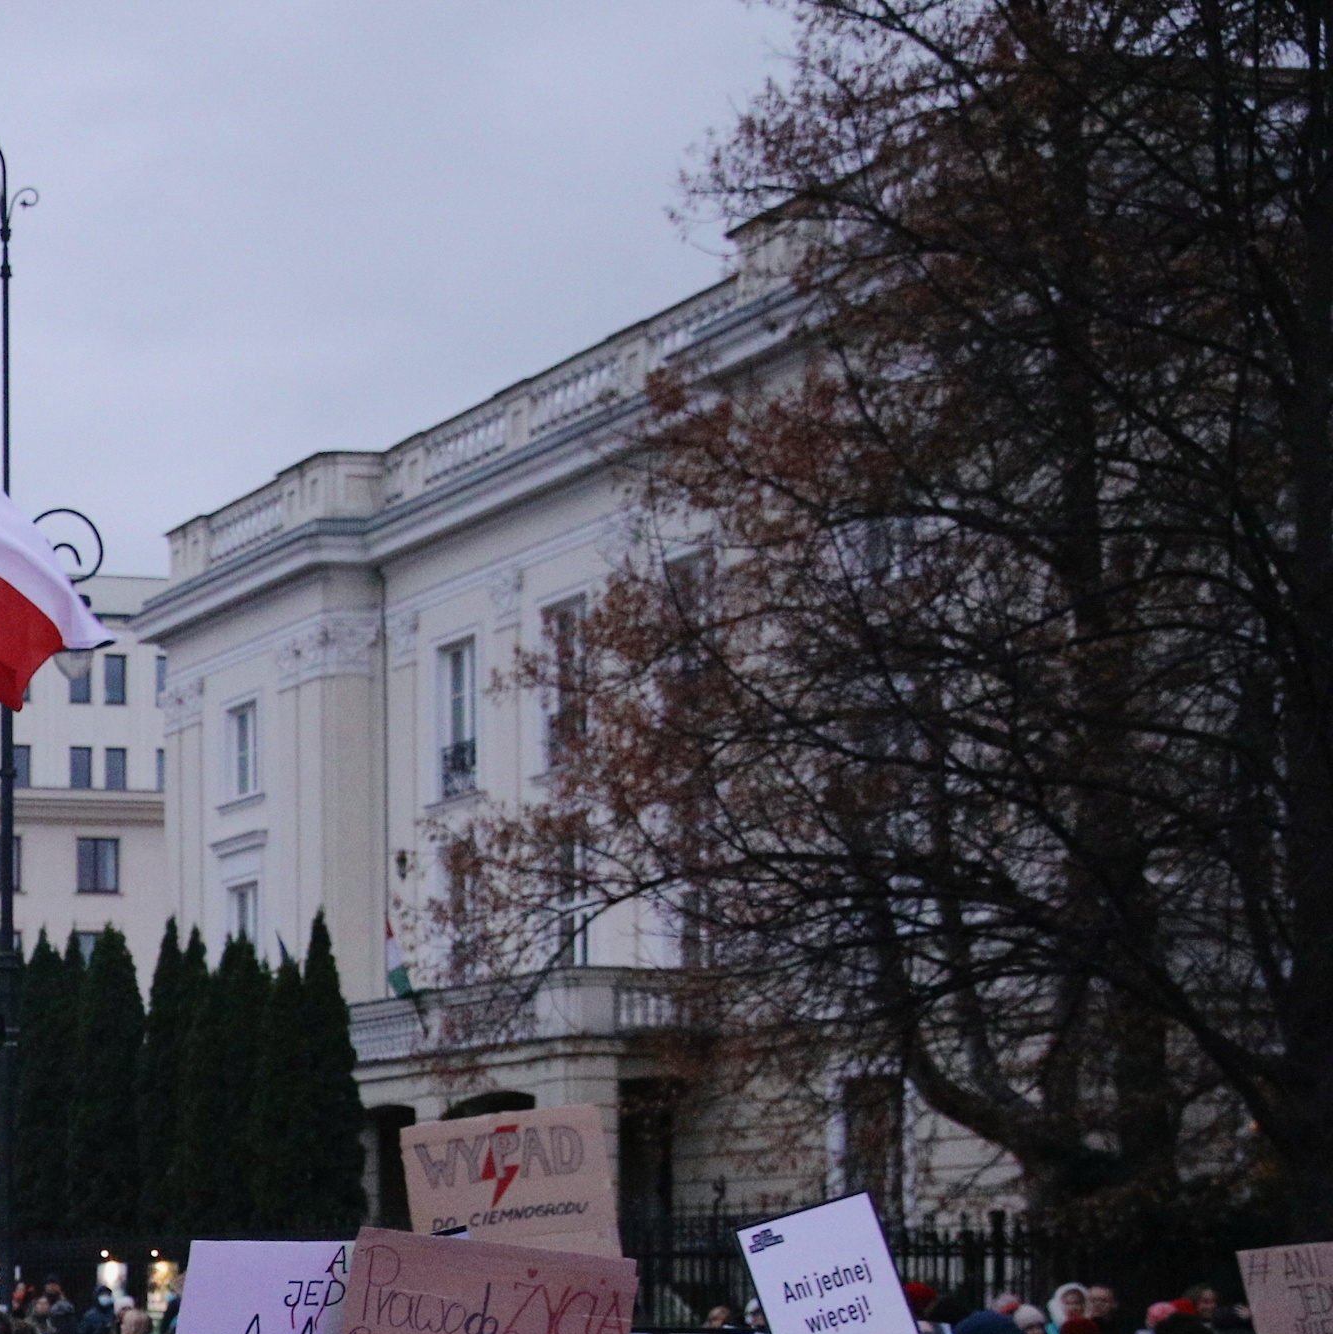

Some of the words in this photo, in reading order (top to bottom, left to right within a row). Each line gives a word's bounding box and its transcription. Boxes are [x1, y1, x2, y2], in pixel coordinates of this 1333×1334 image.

[414, 1125, 584, 1189] WYPAD
[360, 1244, 468, 1334] Prawo
[783, 1275, 813, 1303] Ani
[813, 1257, 873, 1298] jednej
[805, 1295, 872, 1334] więcej!
